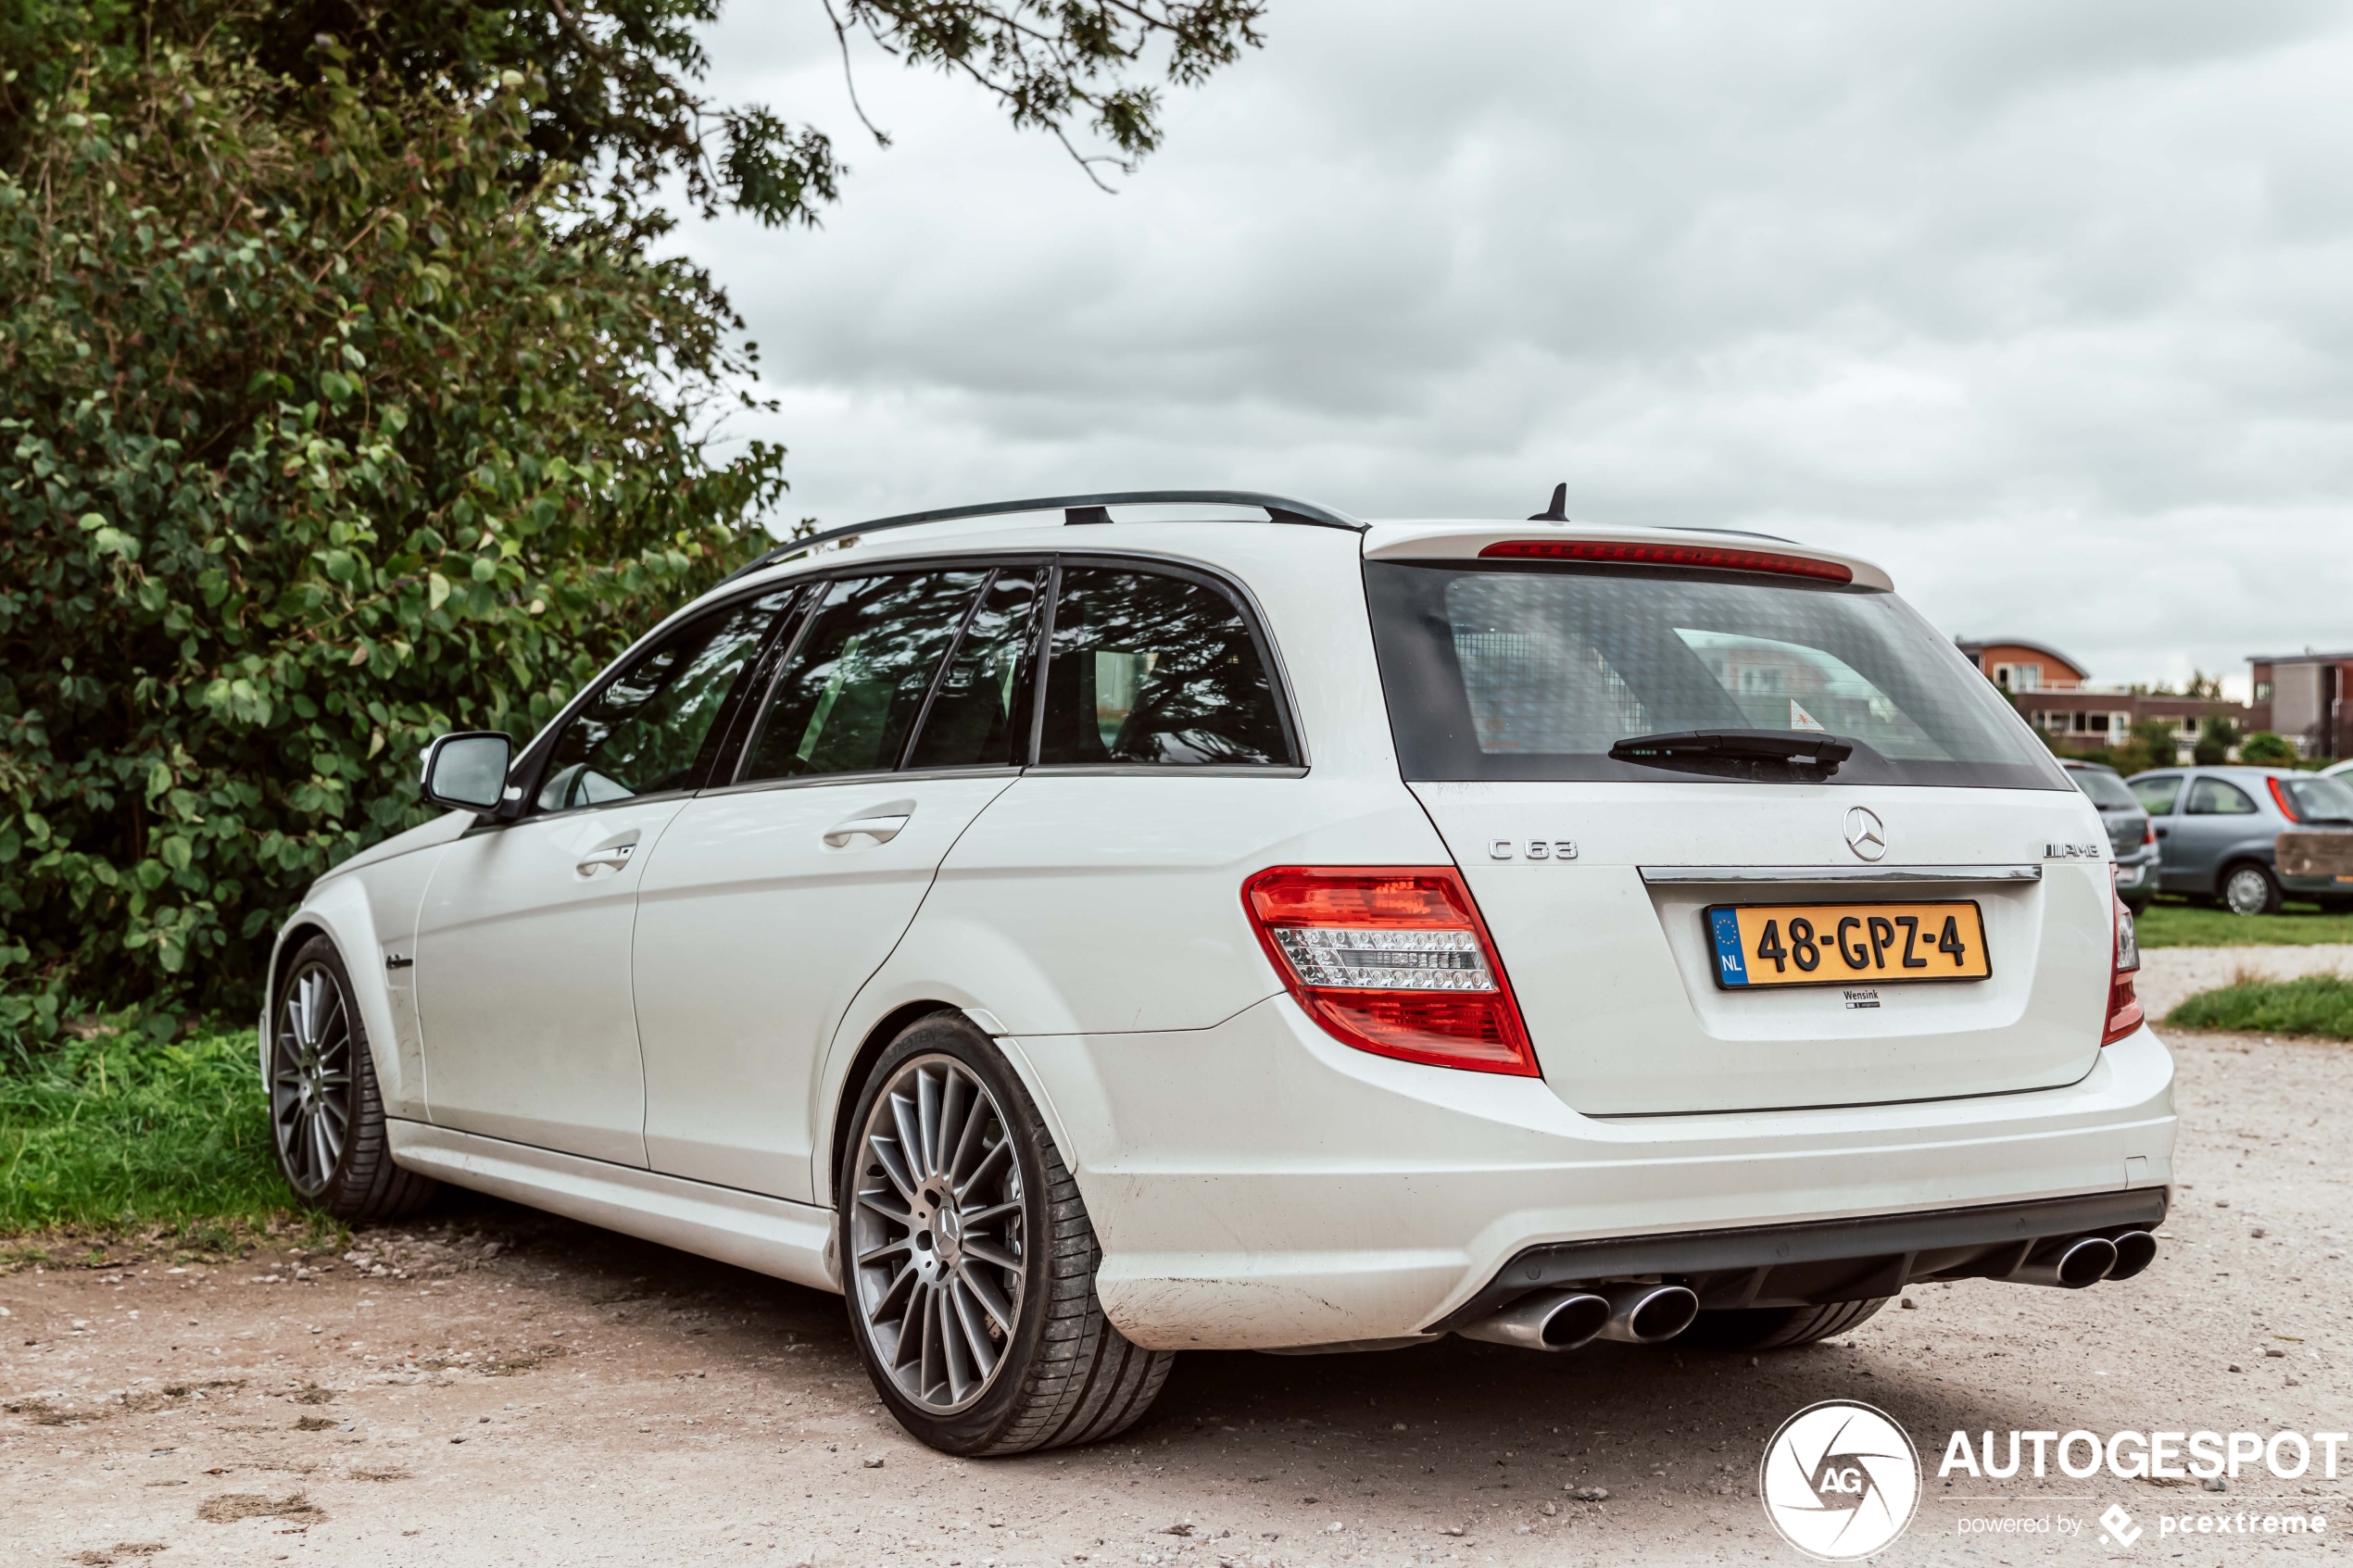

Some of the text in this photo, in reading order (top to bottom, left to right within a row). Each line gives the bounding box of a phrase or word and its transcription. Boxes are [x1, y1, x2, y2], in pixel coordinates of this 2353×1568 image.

[1489, 839, 1579, 859] C 63
[2062, 843, 2101, 858] AMG
[1757, 915, 1966, 972] 48-GPZ-4
[1721, 955, 1743, 972] NL
[1843, 989, 1879, 1000] Wensink
